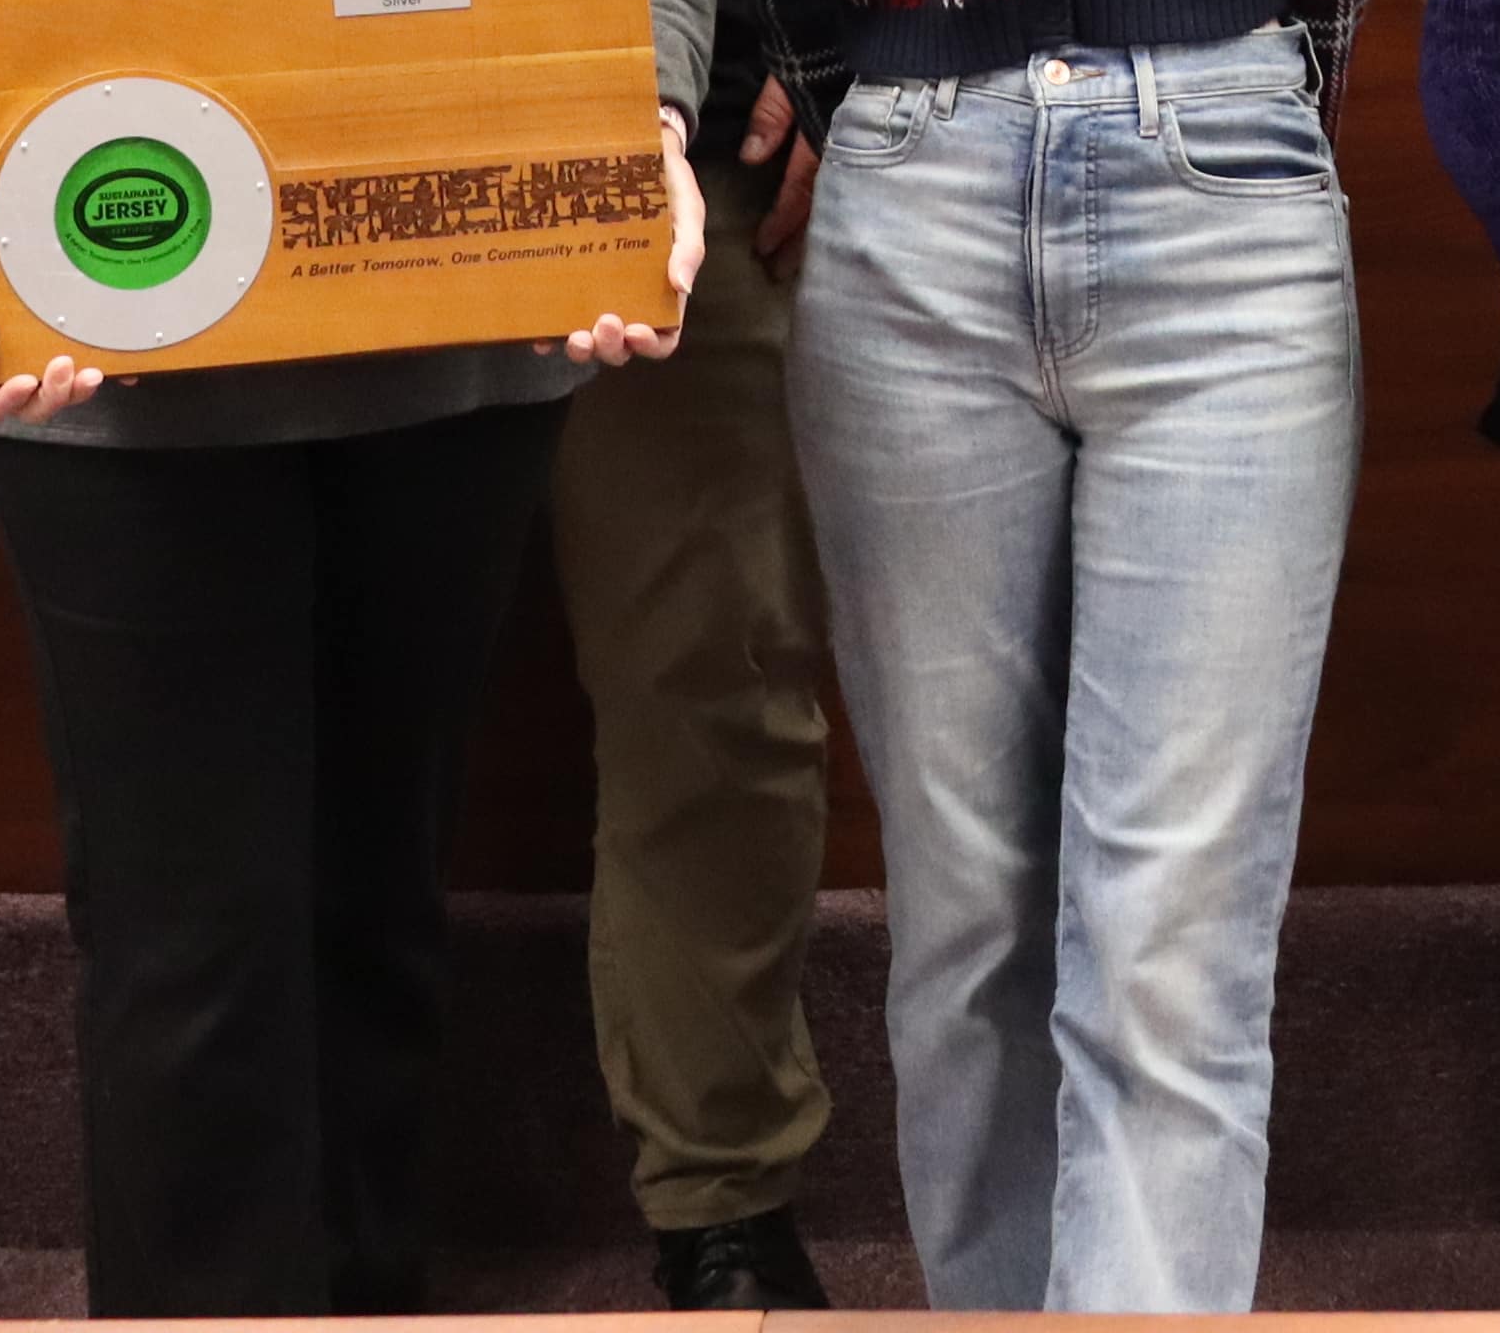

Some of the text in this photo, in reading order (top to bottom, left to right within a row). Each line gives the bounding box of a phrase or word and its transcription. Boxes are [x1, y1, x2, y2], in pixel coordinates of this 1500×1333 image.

[98, 187, 166, 201] SUSTAINABLE
[91, 199, 168, 221] JERSEY
[291, 264, 303, 278] A
[308, 262, 357, 277] Better
[451, 251, 482, 265] One
[487, 242, 573, 261] Community
[579, 242, 594, 254] at
[598, 242, 608, 252] a
[614, 237, 650, 250] Time
